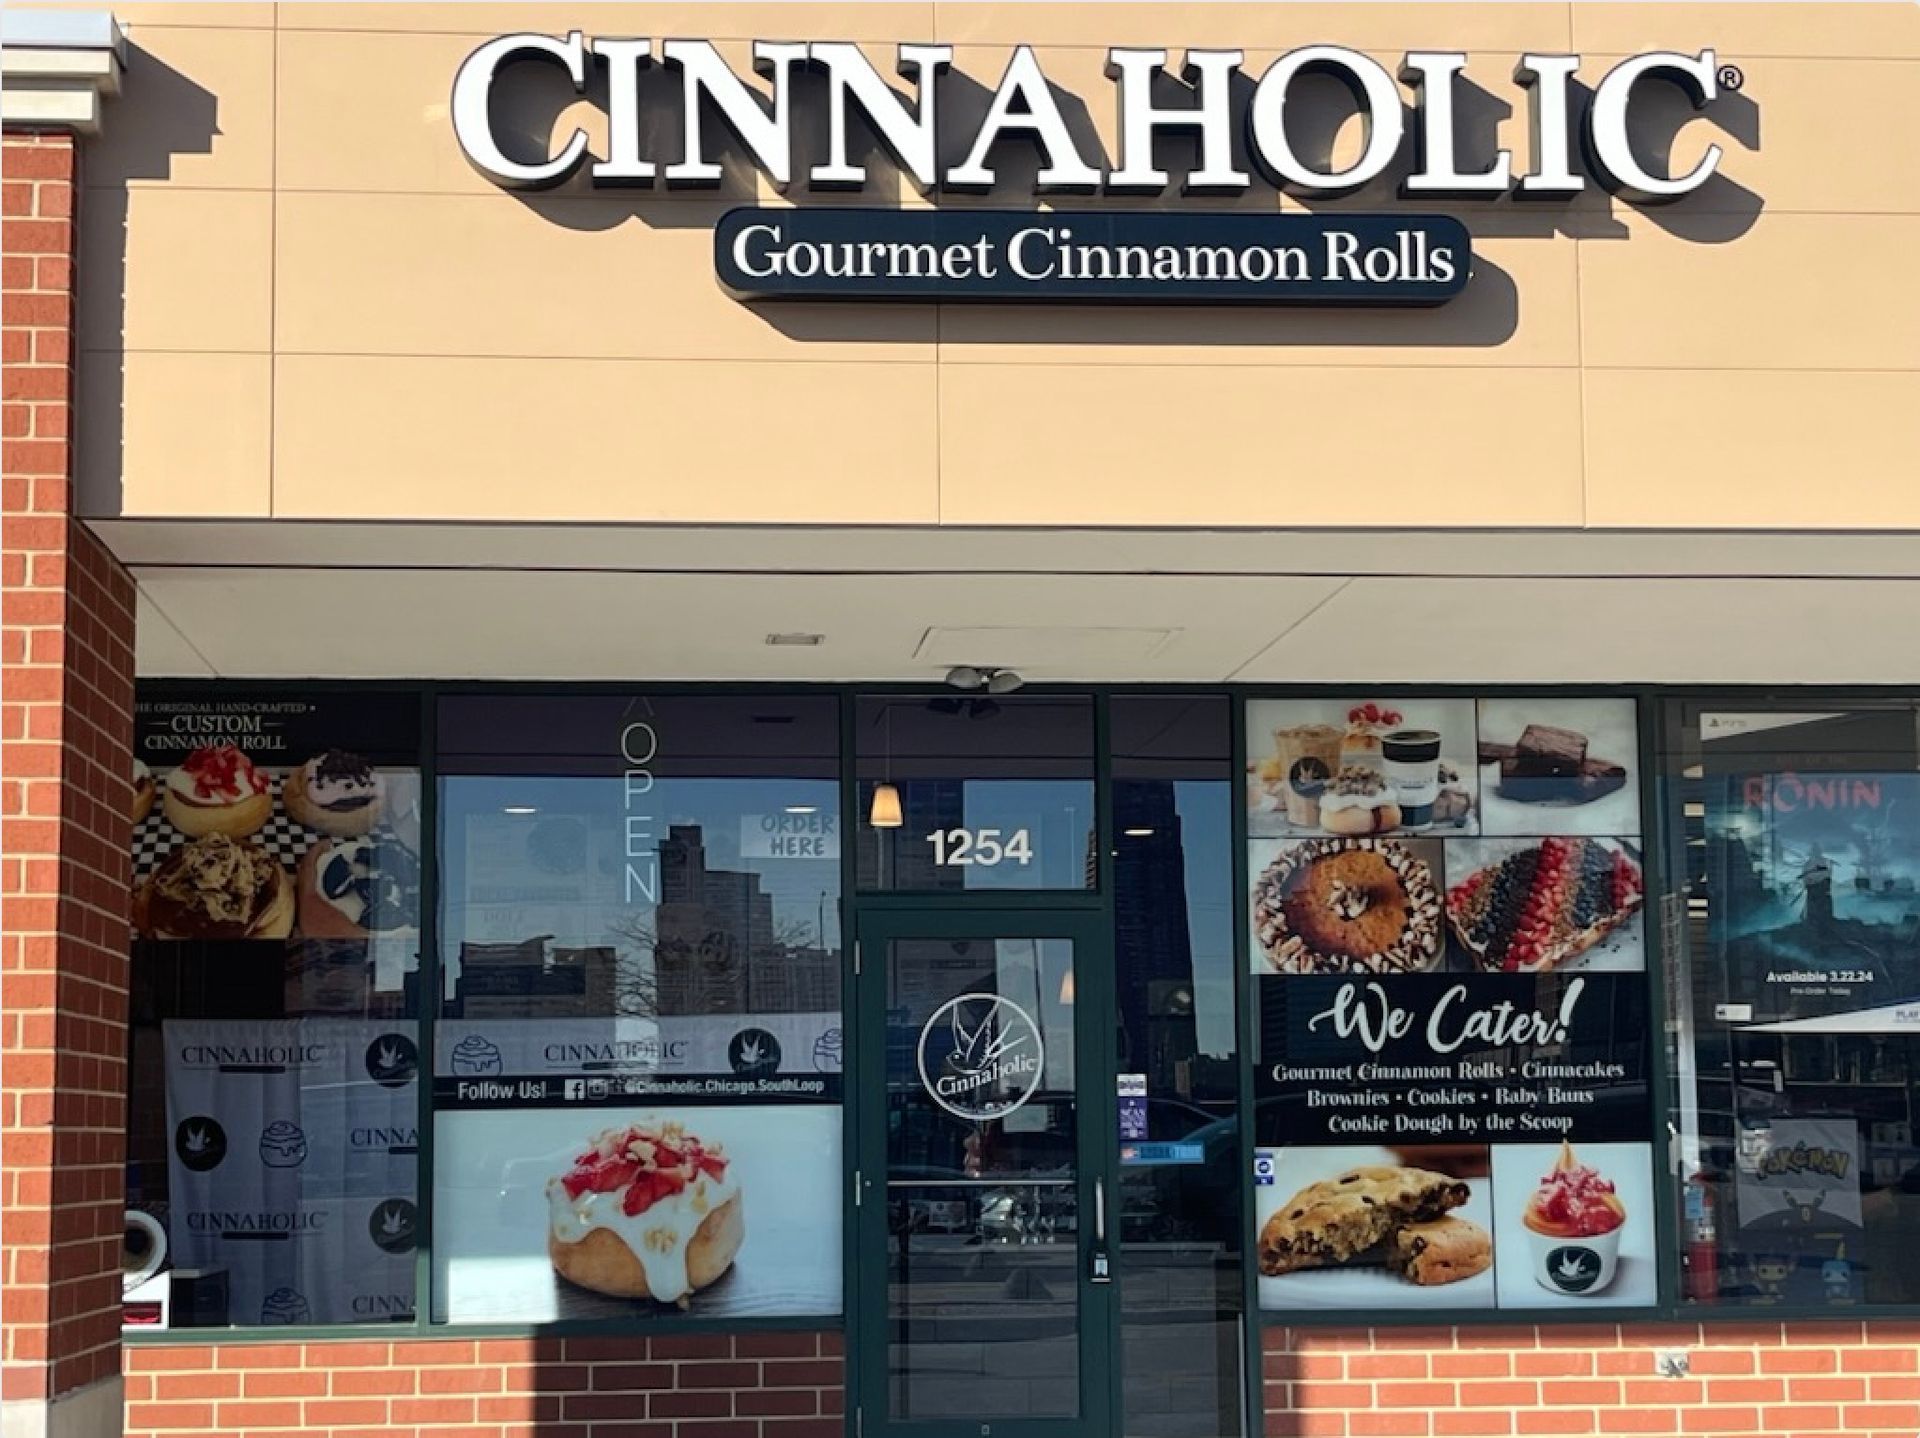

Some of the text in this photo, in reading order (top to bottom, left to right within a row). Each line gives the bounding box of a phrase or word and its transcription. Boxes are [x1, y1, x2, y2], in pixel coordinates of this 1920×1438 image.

[732, 224, 1456, 285] Gourmet Cinnamon Rolls
[154, 702, 213, 713] ORIGINAL
[216, 702, 307, 713] HAND-CRAFTED
[170, 714, 263, 733] CUSTOM
[144, 734, 287, 750] CINNAMON ROLL
[620, 722, 658, 904] OPEN
[761, 814, 835, 835] ORDER
[769, 837, 825, 857] HERE
[926, 828, 1033, 866] 1254
[1765, 971, 1827, 983] Available
[1308, 977, 1586, 1054] We Cater!
[181, 1045, 325, 1065] CINNAHOLIC
[937, 1053, 1038, 1096] Cinnaholic
[1272, 1060, 1625, 1082] Gourmet Cinnamon Rolls Cinnacakes
[457, 1081, 515, 1100] Follow
[519, 1080, 547, 1098] Us!
[1306, 1086, 1595, 1109] Brownies Cookies Baby Buns
[1328, 1112, 1575, 1135] Cookie Dough by the Scoop
[186, 1211, 325, 1231] CINNAHOLIC
